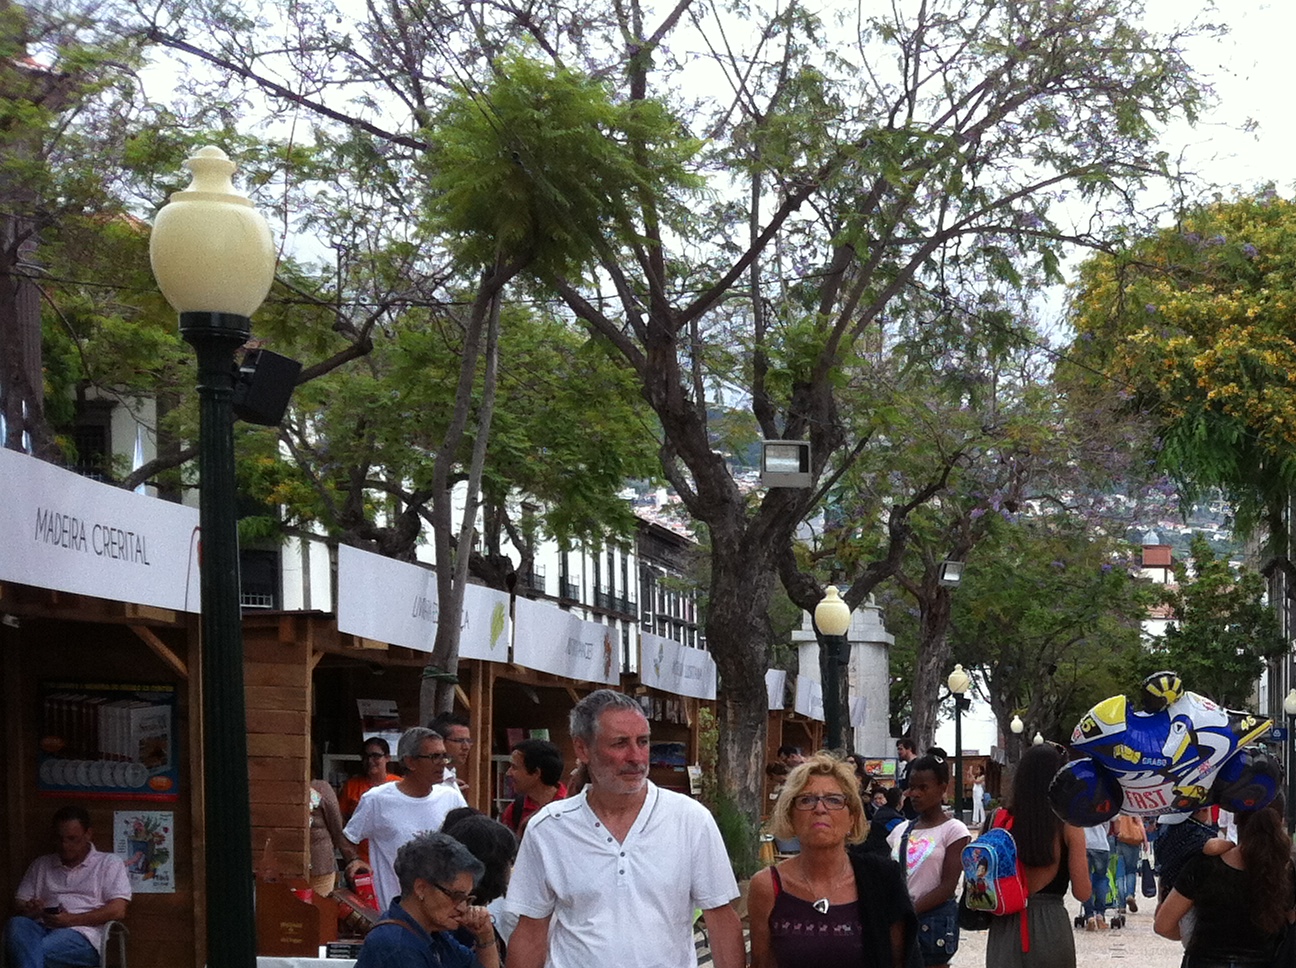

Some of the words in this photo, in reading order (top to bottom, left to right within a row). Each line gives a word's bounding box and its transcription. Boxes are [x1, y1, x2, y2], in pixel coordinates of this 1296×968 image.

[35, 507, 88, 552] MADEIRA
[92, 523, 150, 566] CRERITAL
[1124, 788, 1169, 811] FAST
